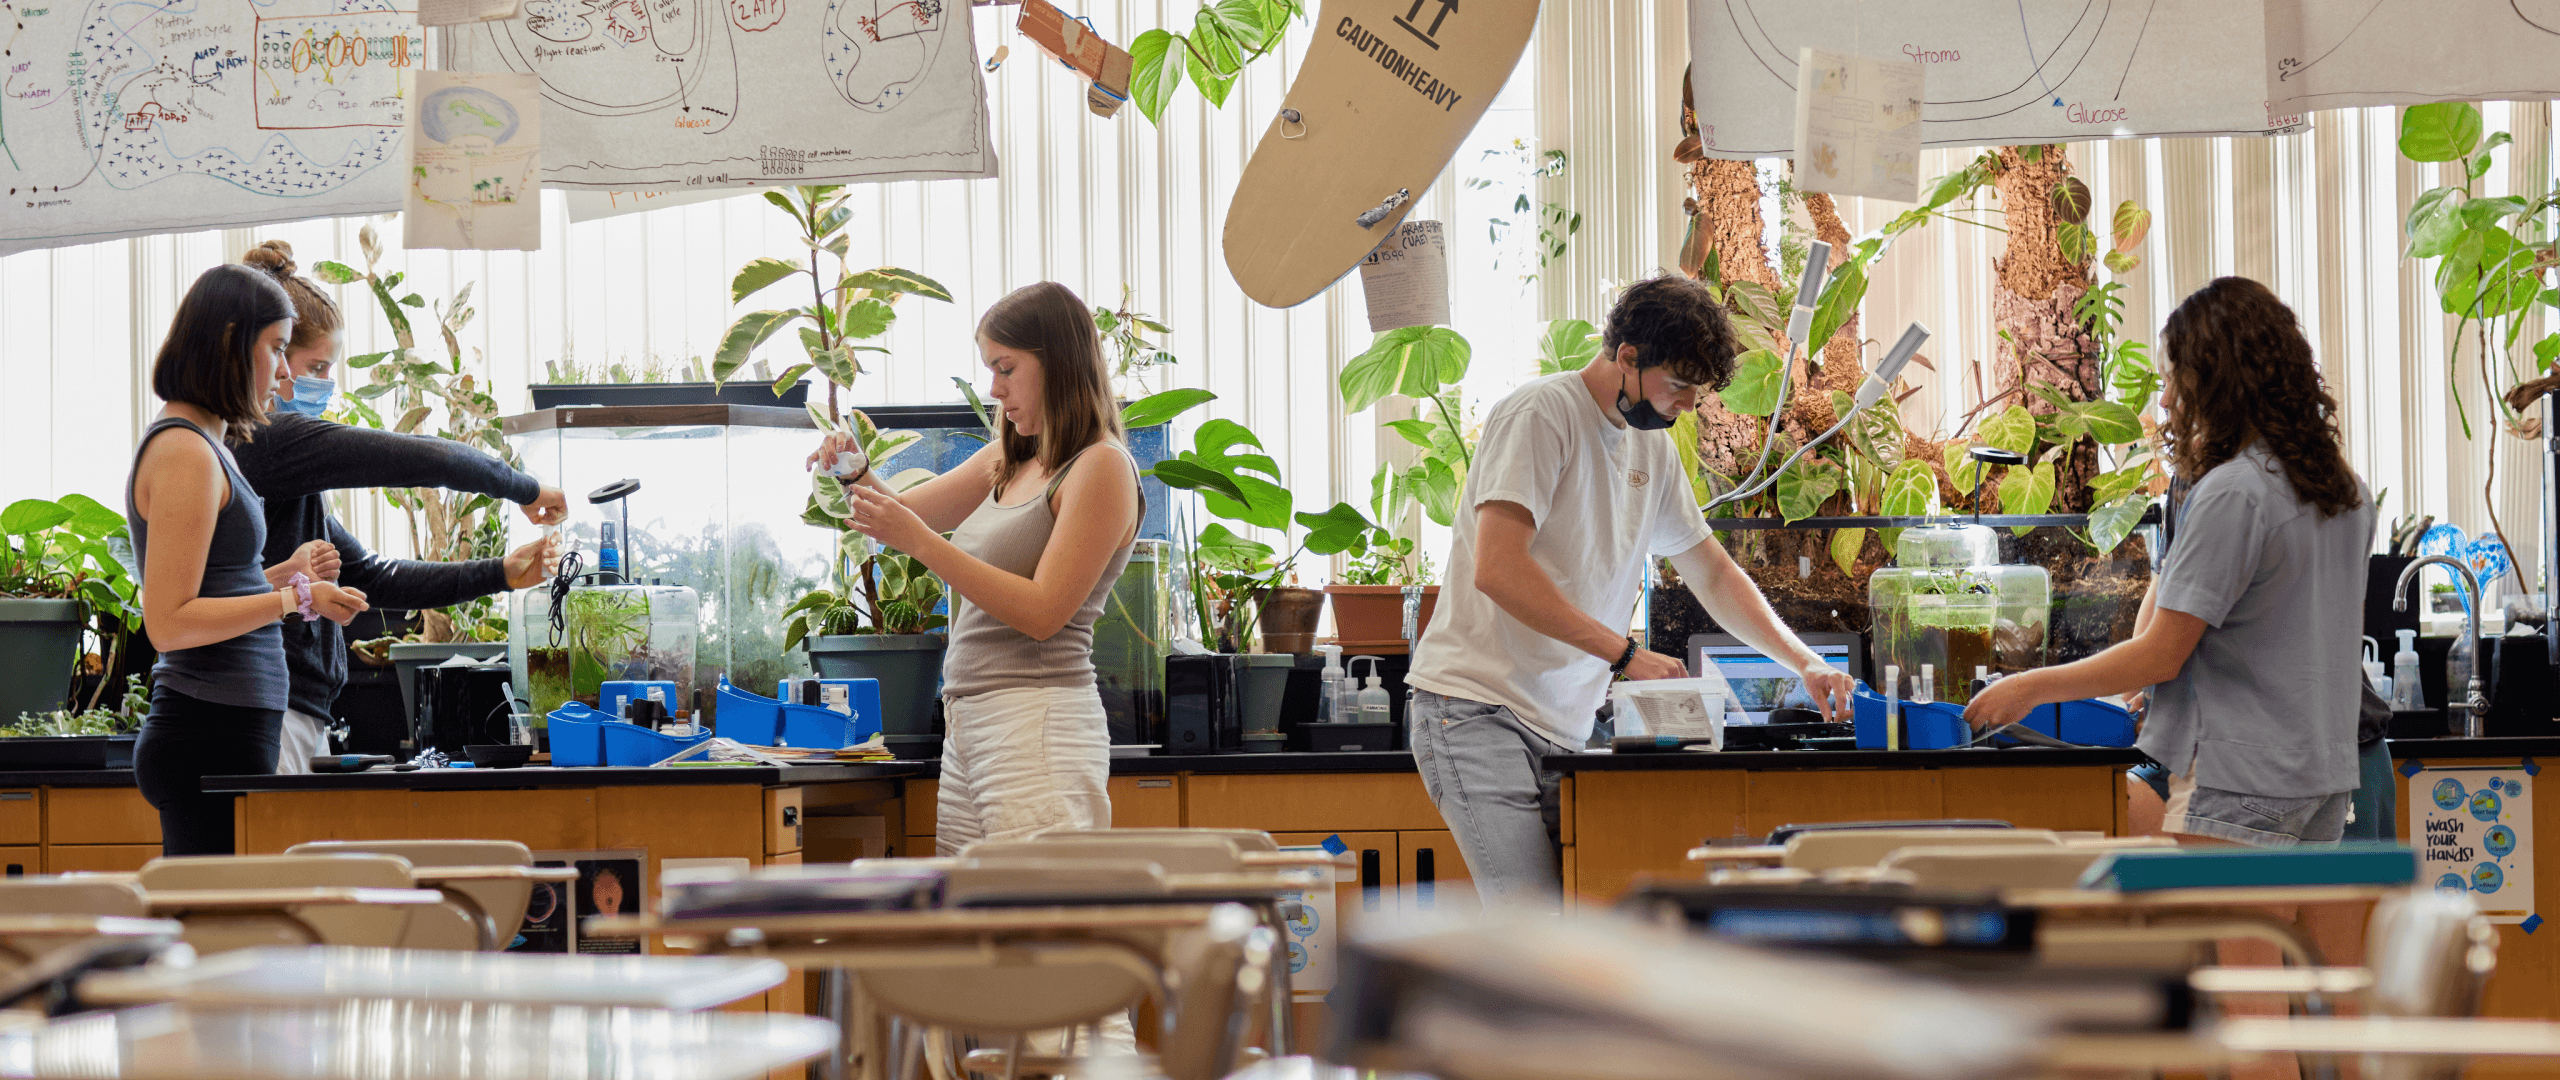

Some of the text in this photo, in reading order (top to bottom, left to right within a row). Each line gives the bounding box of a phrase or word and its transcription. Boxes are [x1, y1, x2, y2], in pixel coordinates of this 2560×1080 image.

[738, 0, 777, 21] 2 ATP
[607, 19, 636, 43] ATP
[1902, 43, 1962, 64] Stroma
[215, 54, 249, 72] NADH
[23, 88, 51, 99] NADH
[129, 114, 149, 127] ATP
[2066, 101, 2129, 125] Glucose
[674, 116, 712, 129] Glucose
[707, 173, 729, 183] wall
[1402, 222, 1424, 236] ARAB
[1402, 233, 1429, 250] (UAE)
[2426, 834, 2458, 847] YOUR
